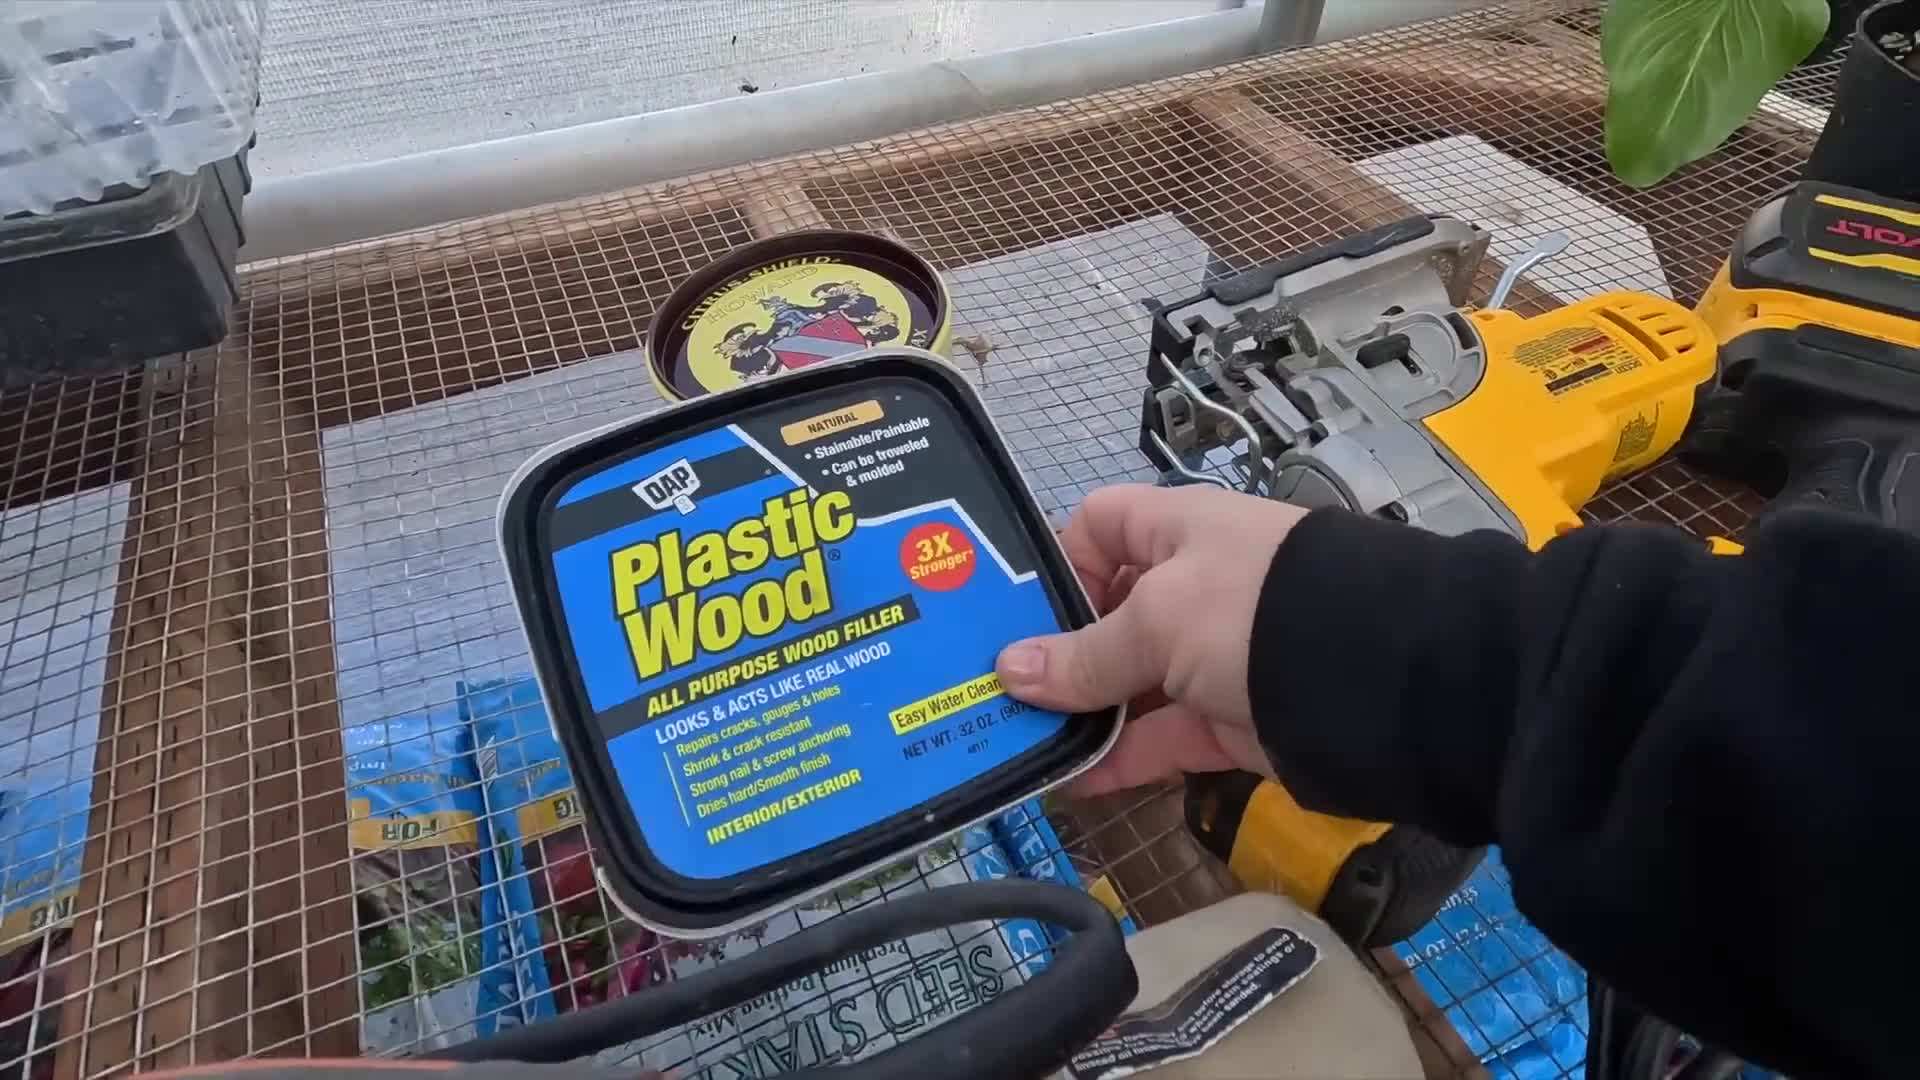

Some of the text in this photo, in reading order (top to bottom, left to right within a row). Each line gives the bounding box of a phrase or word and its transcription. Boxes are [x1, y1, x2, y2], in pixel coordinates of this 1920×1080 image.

[808, 412, 858, 433] NATURAL
[814, 416, 930, 459] Stainable/Paintable
[643, 466, 690, 504] DAP
[831, 436, 930, 475] Can be troweled
[846, 460, 904, 487] & molded
[612, 489, 855, 616] Plastic
[915, 531, 953, 562] 3X
[623, 550, 831, 682] Wood
[647, 607, 905, 718] ALL PURPOSE WOOD FILLER
[656, 642, 892, 745] LOOKS & ACTS LIKE REAL WOOD
[676, 732, 719, 757] Repairs
[762, 700, 801, 724] gouges
[802, 694, 812, 706] &
[812, 685, 841, 702] holes
[895, 706, 927, 728] Easy
[928, 691, 965, 715] Water
[683, 716, 812, 777] Shrink & crack resistant
[690, 722, 851, 797] Strong nail & screw anchoring
[903, 738, 928, 760] NET
[931, 728, 957, 748] WT.
[958, 720, 975, 736] 32
[697, 753, 832, 818] Dries hard/Smooth finish
[707, 768, 862, 845] INTERIOR/EXTERIOR
[879, 944, 1004, 1033] SEED
[696, 1008, 738, 1039] Mix
